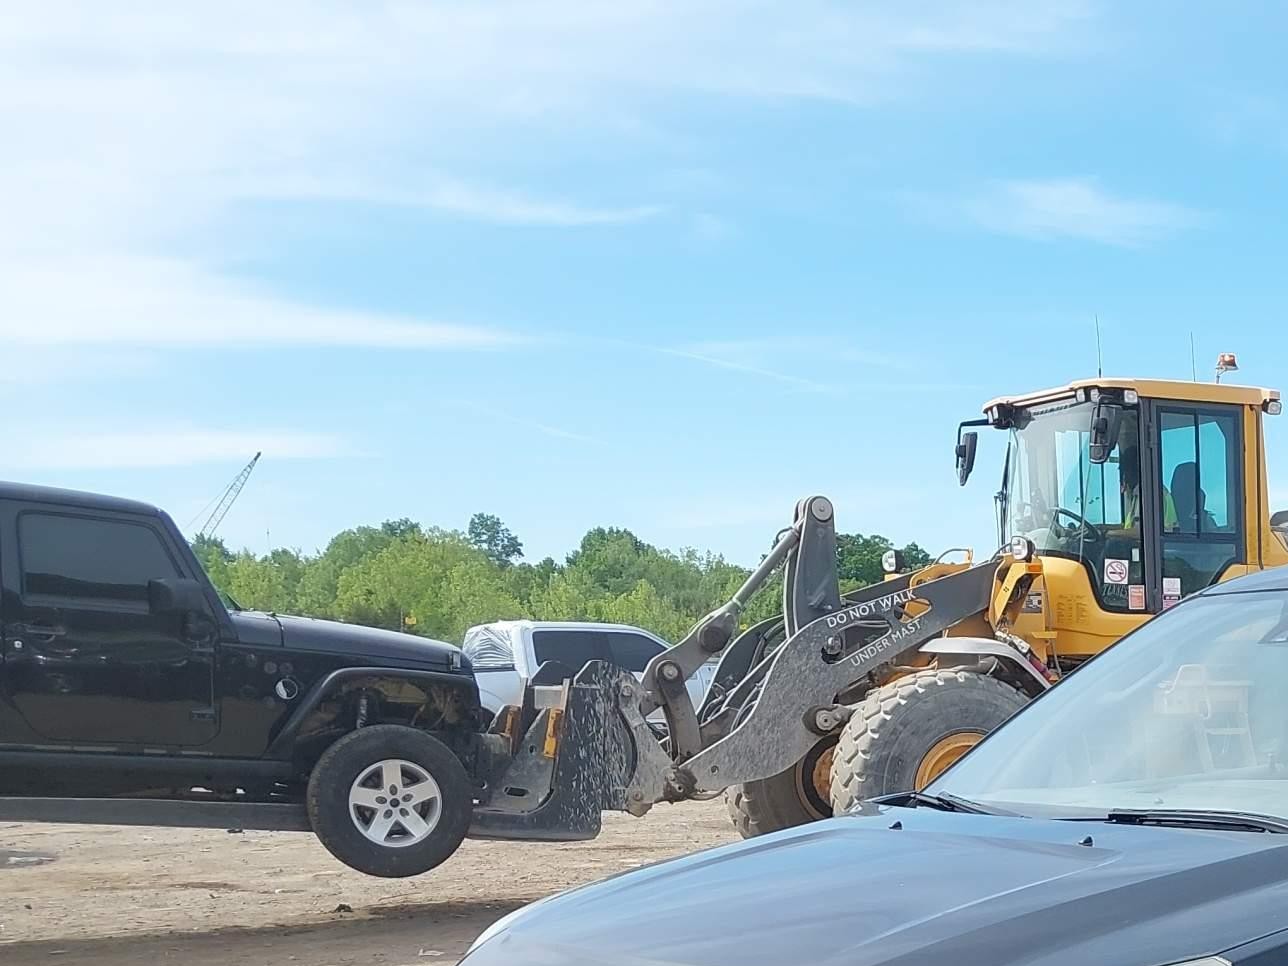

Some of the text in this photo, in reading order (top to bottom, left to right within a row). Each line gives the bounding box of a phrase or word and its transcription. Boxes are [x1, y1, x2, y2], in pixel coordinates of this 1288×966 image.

[826, 590, 916, 628] DO NOT WALK
[850, 619, 921, 666] UNDER MAST
